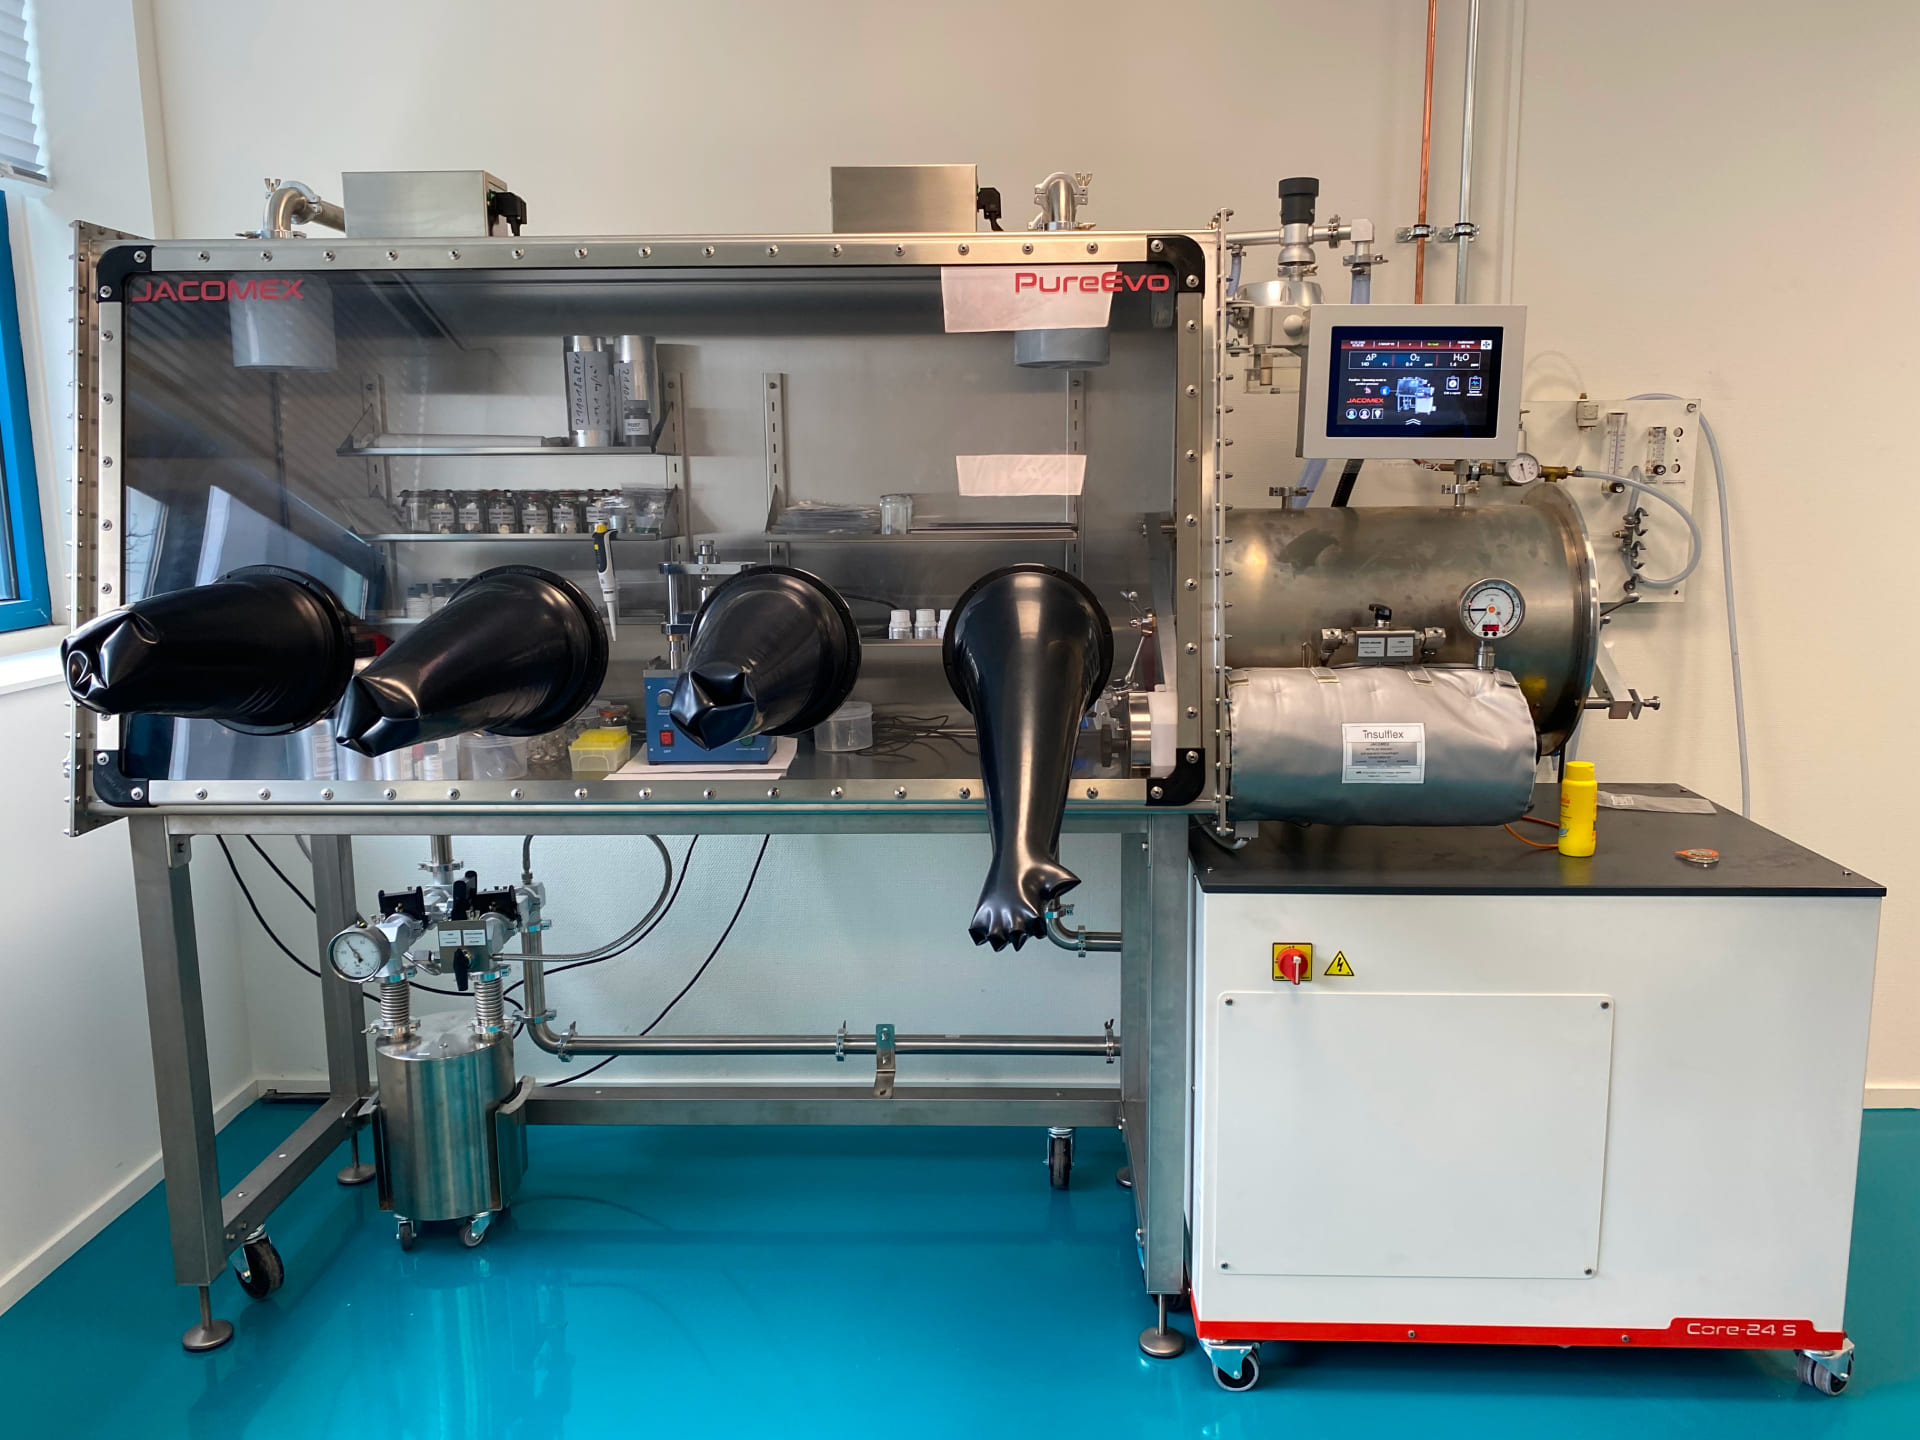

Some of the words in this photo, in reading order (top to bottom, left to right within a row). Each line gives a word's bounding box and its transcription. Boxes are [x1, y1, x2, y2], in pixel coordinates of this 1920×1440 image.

[131, 279, 304, 302] JACOMEX
[1015, 270, 1170, 293] PureEvo
[1686, 1322, 1776, 1336] Core-24
[1782, 1324, 1797, 1337] S
